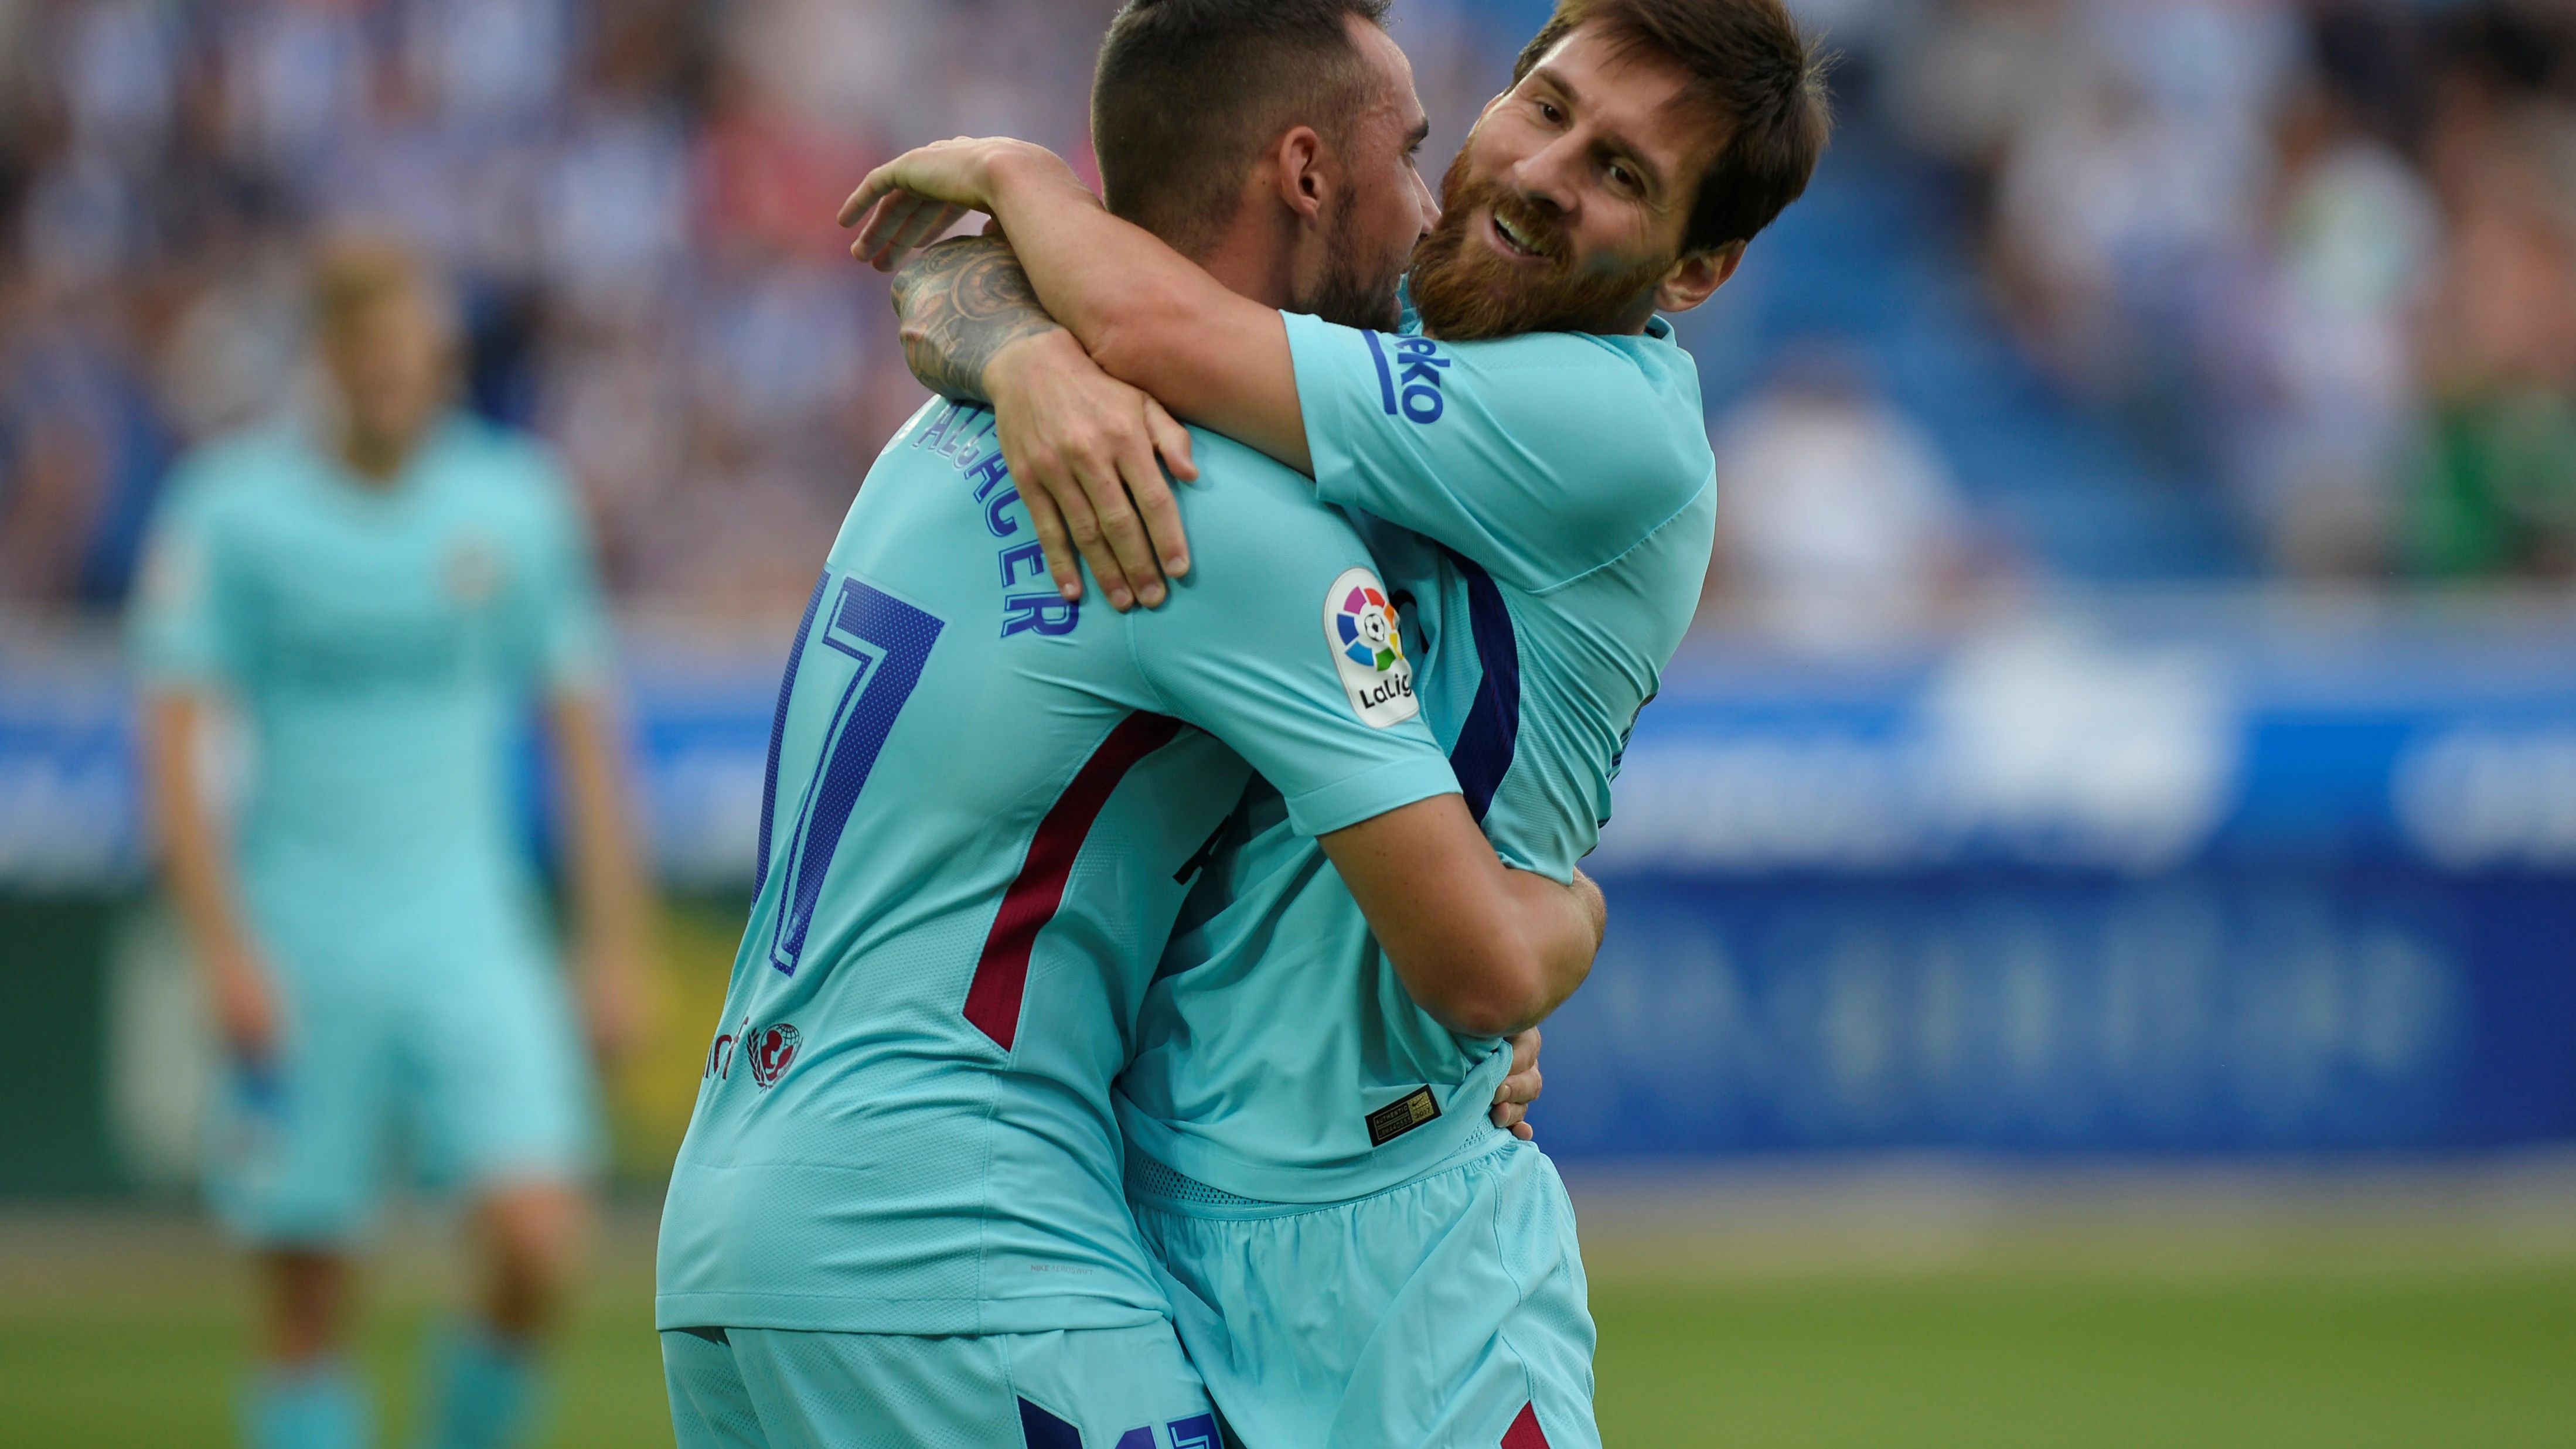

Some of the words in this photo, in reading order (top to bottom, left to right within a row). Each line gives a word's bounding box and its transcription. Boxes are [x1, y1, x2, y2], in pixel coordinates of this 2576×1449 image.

[1392, 333, 1451, 424] eko
[1359, 673, 1412, 709] LaLig
[1376, 1105, 1408, 1124] AUTHENTIC
[1416, 1108, 1430, 1119] 2017
[1030, 1264, 1050, 1272] NIKE
[1051, 1266, 1094, 1276] AEROSWIFT
